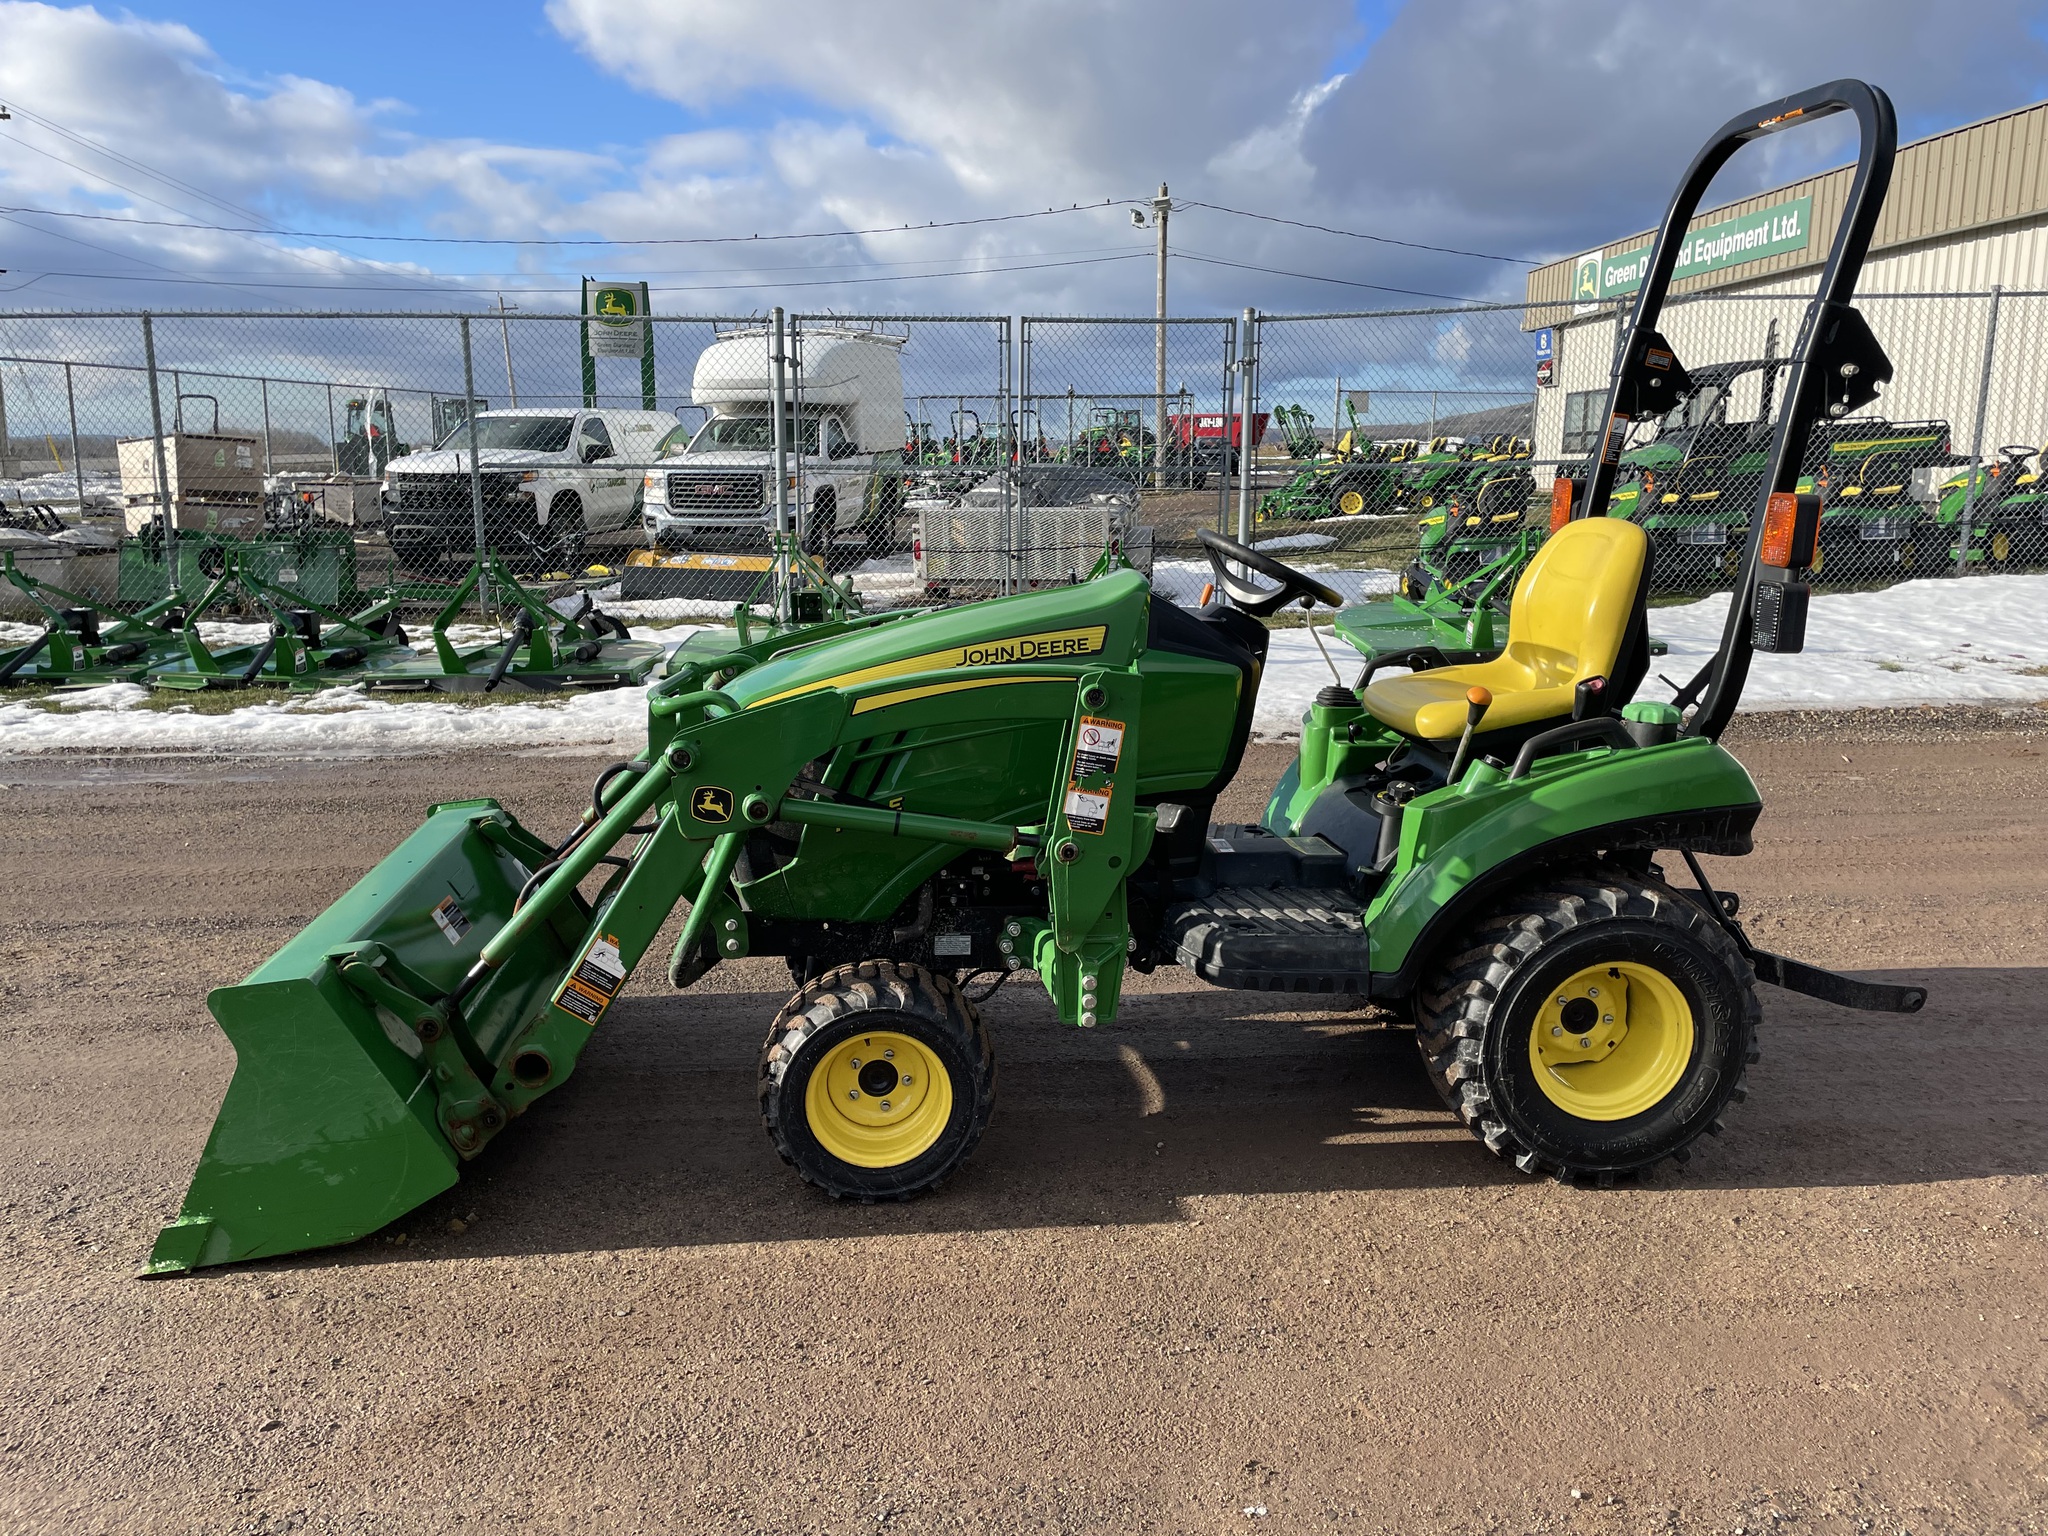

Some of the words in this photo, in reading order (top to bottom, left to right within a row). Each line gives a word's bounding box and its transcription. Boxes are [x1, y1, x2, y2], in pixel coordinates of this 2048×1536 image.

[1605, 264, 1637, 288] Green
[1694, 221, 1769, 265] Equipment
[1771, 210, 1801, 242] Ltd.
[695, 485, 733, 495] GMC
[956, 645, 1014, 666] JOHN
[1020, 638, 1089, 657] DEERE
[1090, 718, 1123, 729] WARNING
[578, 986, 604, 1003] WARNING
